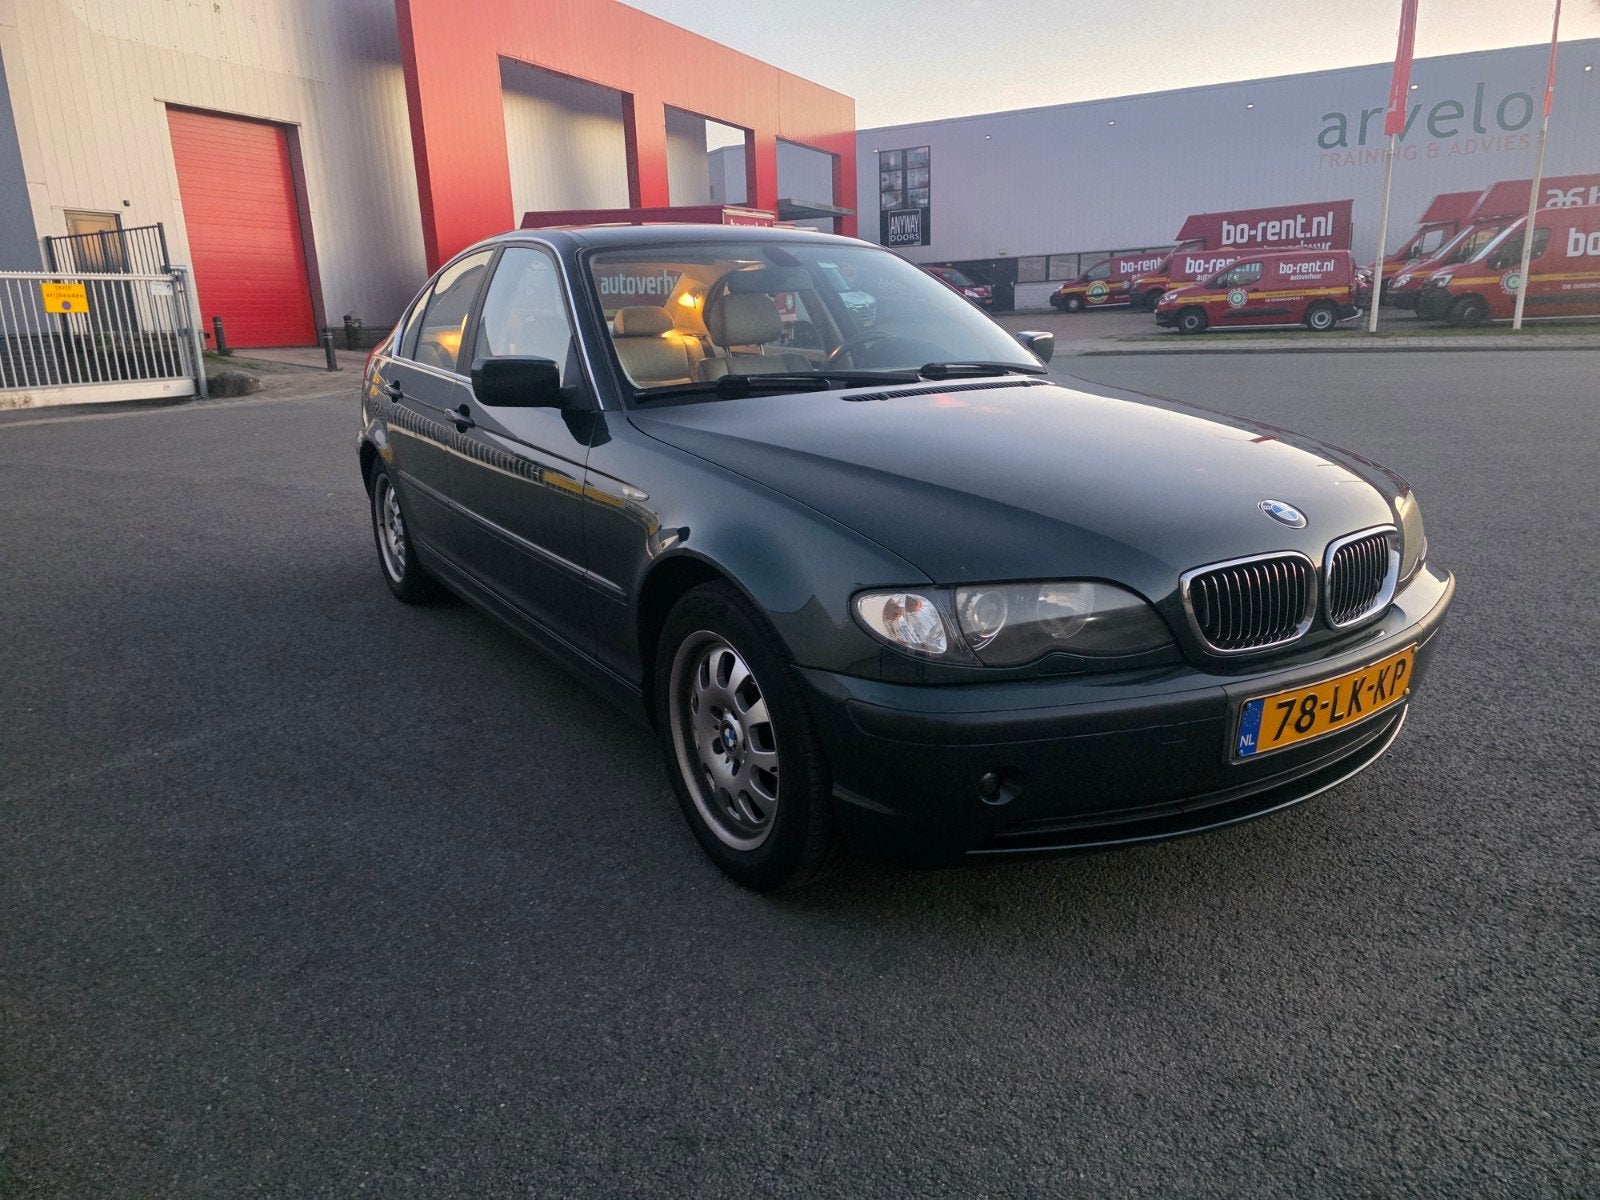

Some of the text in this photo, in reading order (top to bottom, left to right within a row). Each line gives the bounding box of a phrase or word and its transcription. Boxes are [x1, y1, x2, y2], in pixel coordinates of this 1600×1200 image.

[1451, 133, 1531, 155] ADVIES
[890, 214, 920, 235] ANYWAY
[1221, 211, 1334, 245] bo-rent.nl
[890, 232, 920, 242] DOORS
[1279, 259, 1335, 274] bo-rent.nl
[1289, 273, 1323, 281] autoverhuur
[1272, 658, 1407, 742] 78-LK-KP
[1239, 734, 1255, 747] NL
